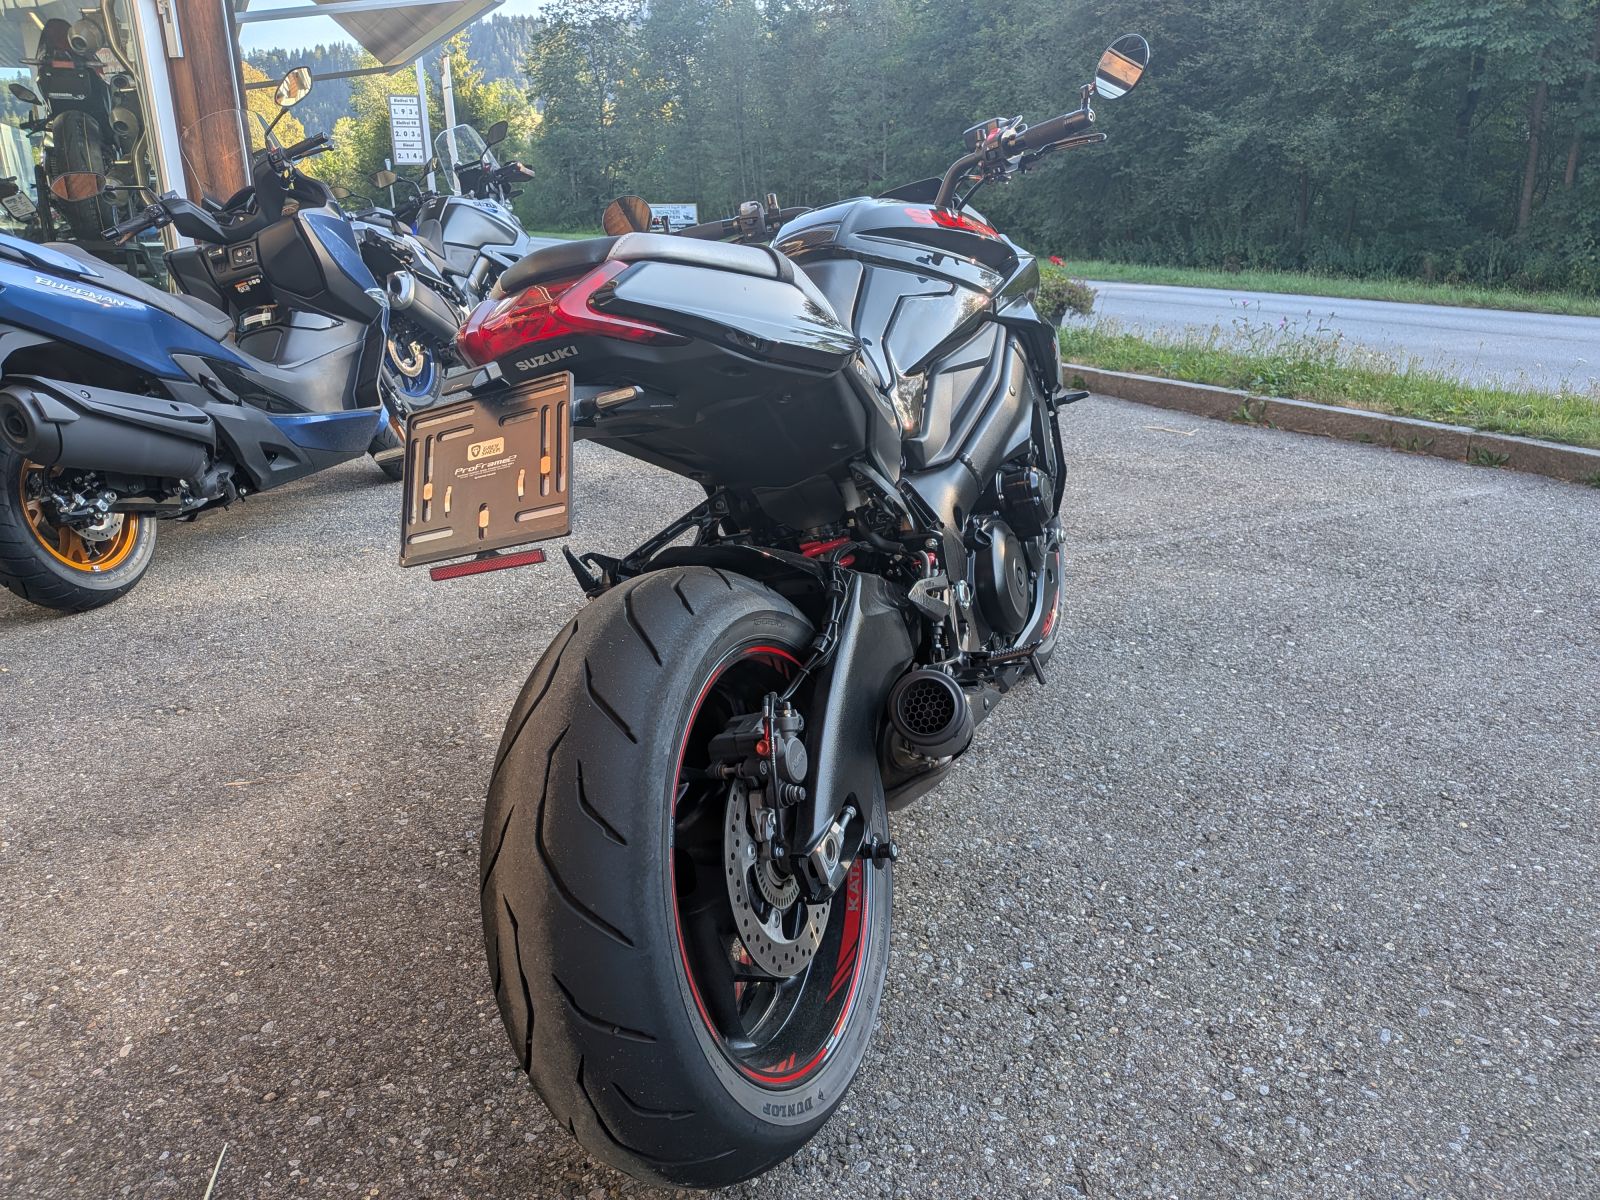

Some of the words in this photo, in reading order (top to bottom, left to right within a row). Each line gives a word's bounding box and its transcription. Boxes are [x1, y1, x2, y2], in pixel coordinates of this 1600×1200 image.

[34, 276, 125, 306] BURGMAN
[515, 345, 579, 371] SUZUKI
[763, 1096, 814, 1117] DUNLOP
